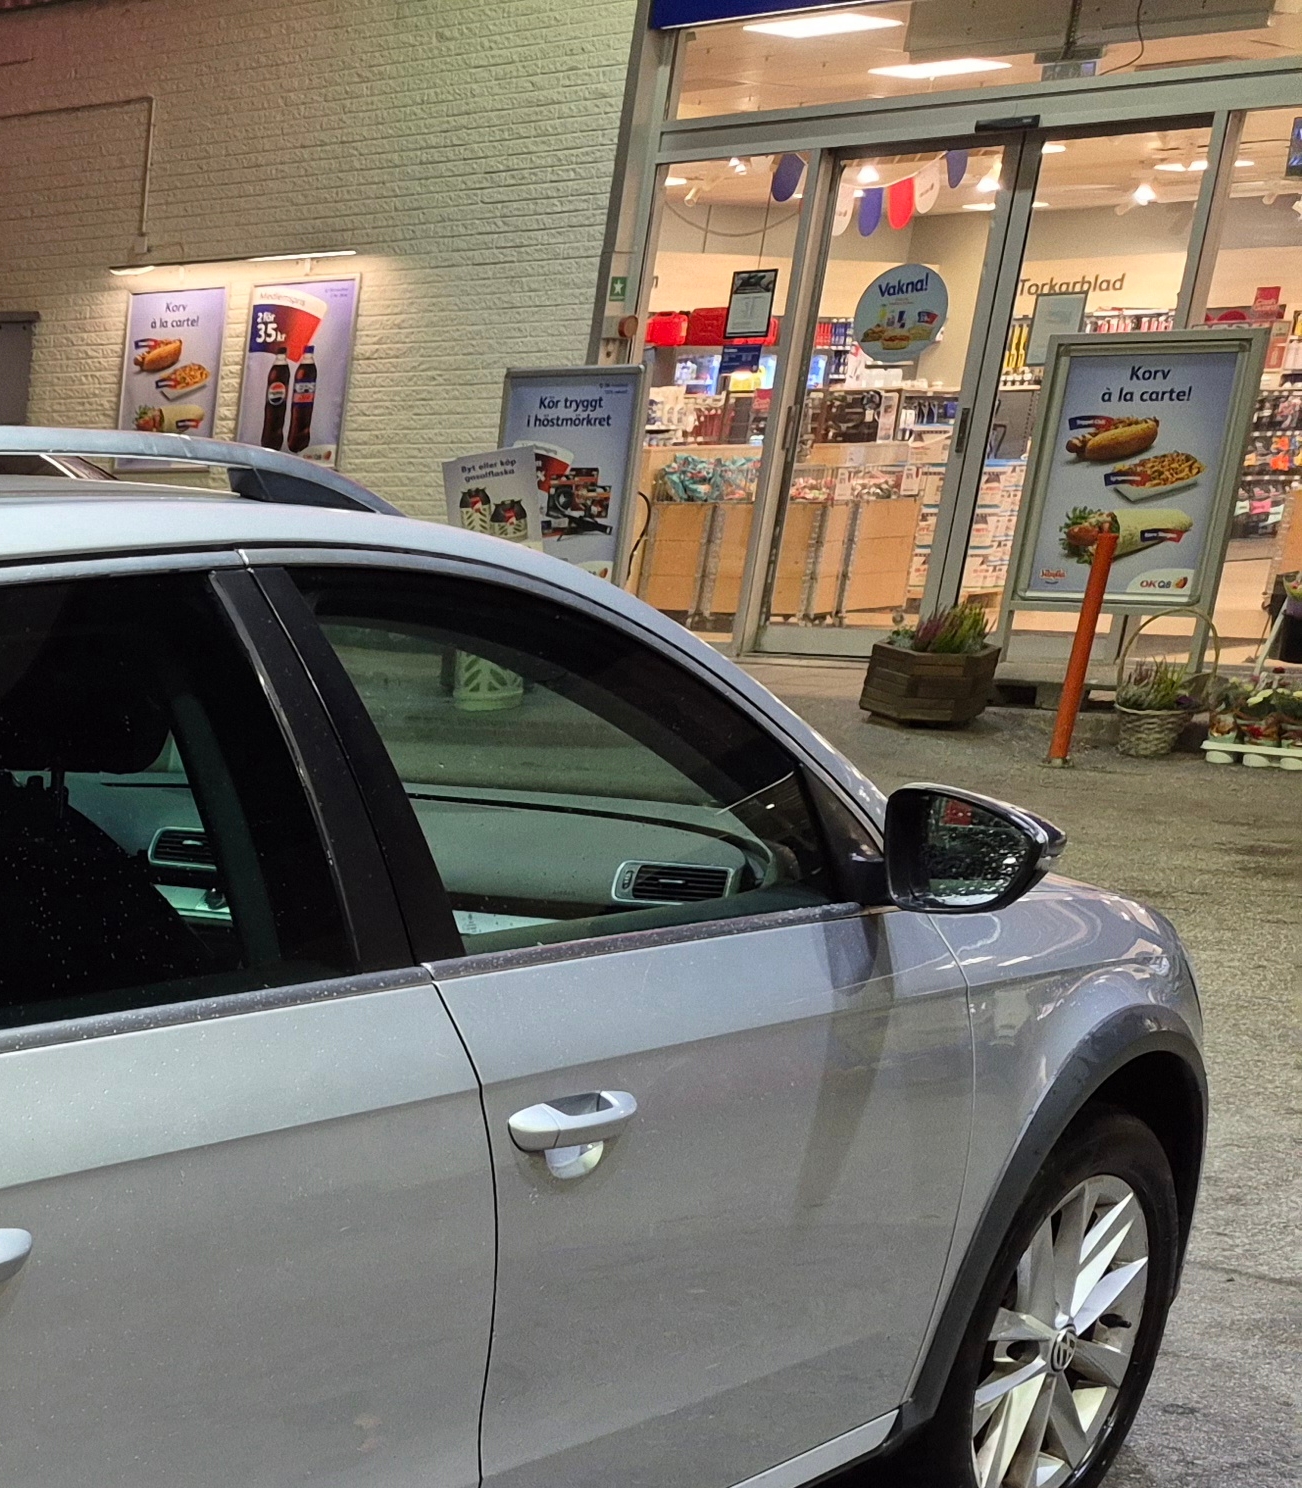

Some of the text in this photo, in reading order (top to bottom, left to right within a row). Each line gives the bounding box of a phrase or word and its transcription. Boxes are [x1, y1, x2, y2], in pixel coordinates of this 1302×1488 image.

[878, 273, 929, 297] Vakna!
[1019, 273, 1126, 296] Torkarblad
[165, 301, 188, 315] Korv
[1129, 365, 1172, 382] Korv
[1101, 386, 1192, 403] à la carte!
[538, 395, 604, 413] Kör tryggt
[527, 413, 612, 428] i höstmörkret
